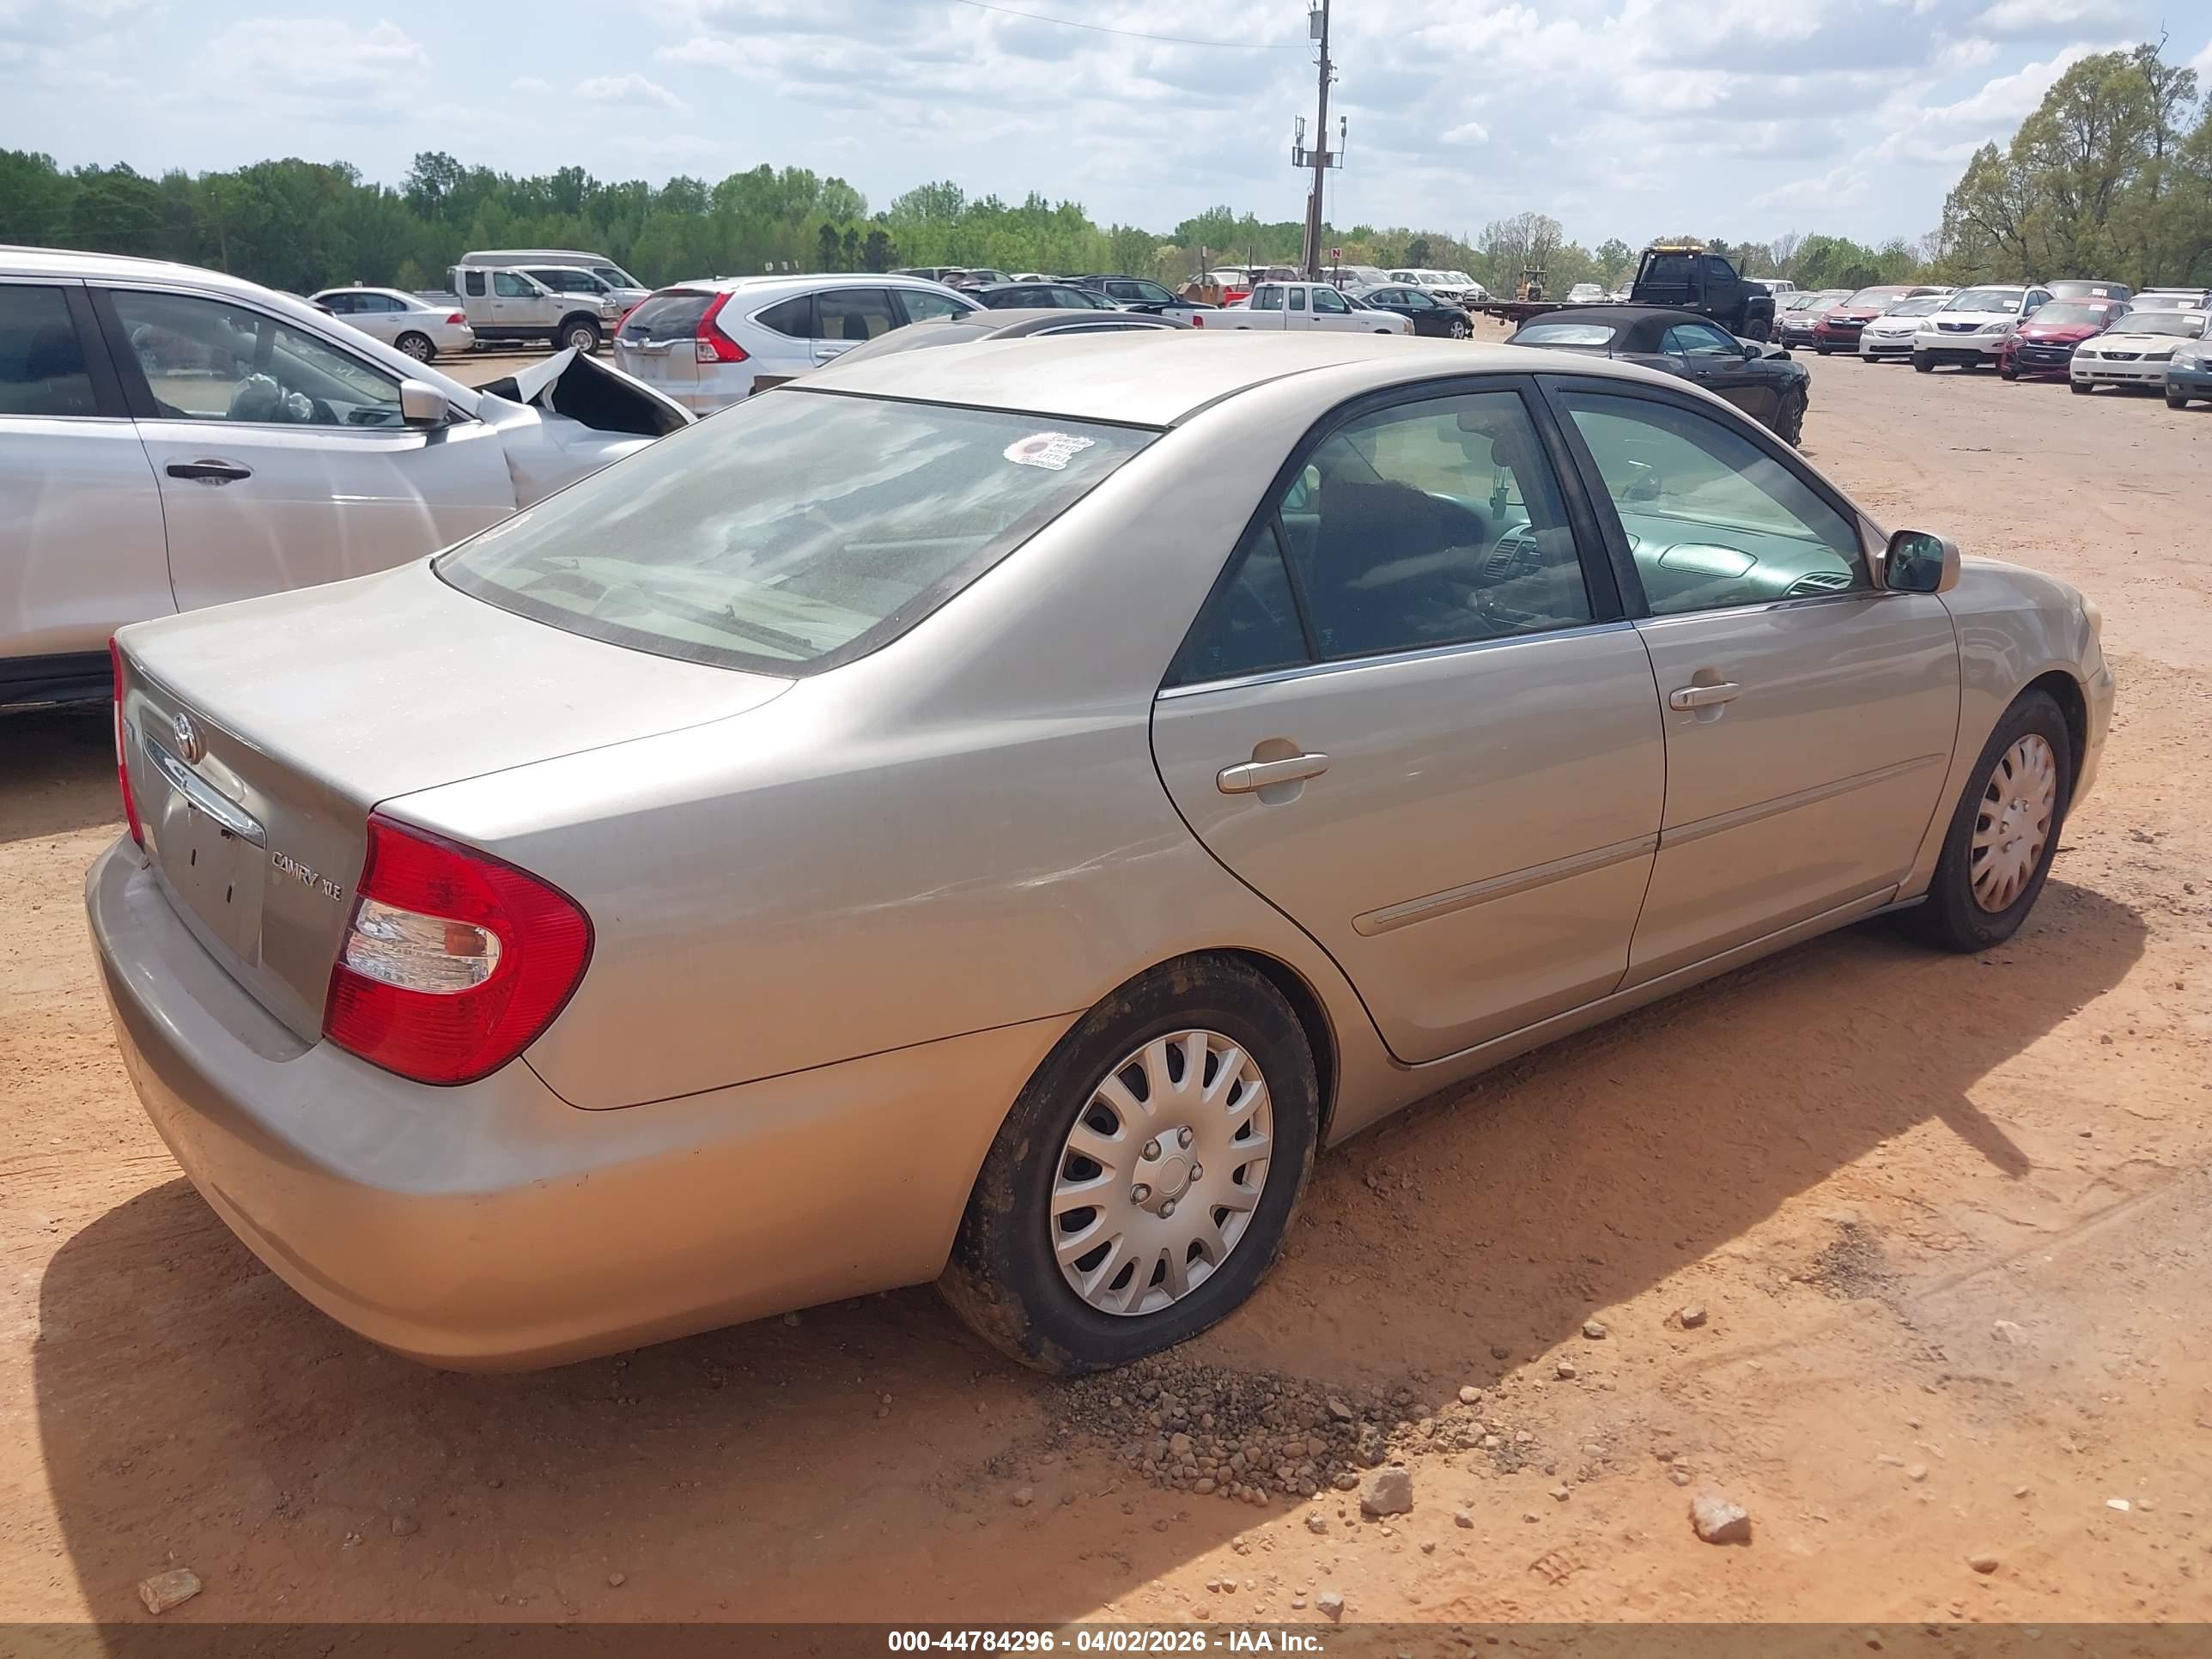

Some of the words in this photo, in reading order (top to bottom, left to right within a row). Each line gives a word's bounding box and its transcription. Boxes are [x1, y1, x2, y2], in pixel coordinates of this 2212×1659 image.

[1332, 249, 1340, 258] N
[1037, 452, 1069, 462] LITTLE
[271, 851, 319, 887] CAMRY
[321, 878, 342, 901] XLE
